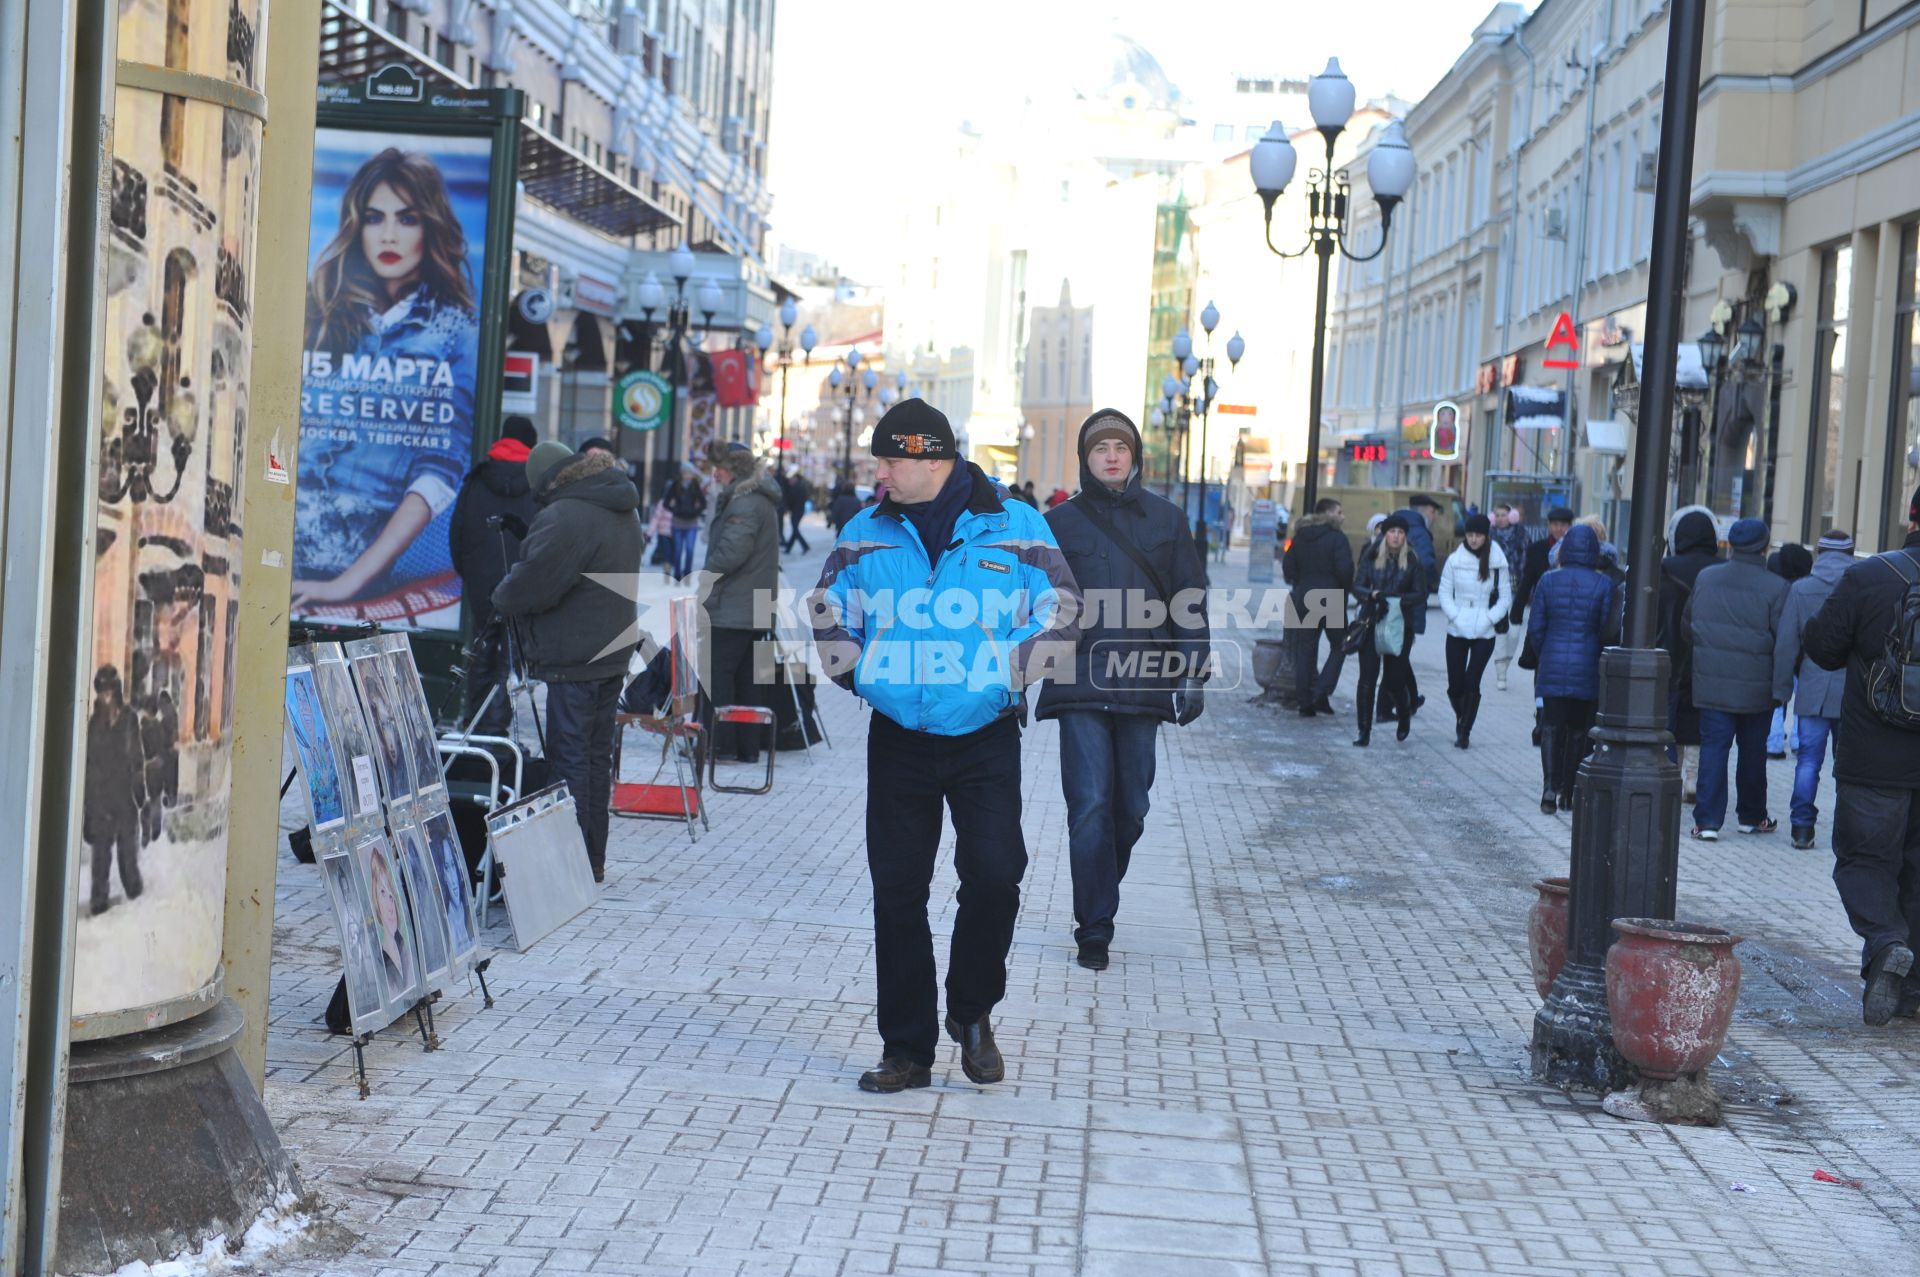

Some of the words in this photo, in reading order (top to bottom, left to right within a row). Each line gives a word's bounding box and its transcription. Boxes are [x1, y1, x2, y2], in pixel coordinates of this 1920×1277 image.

[342, 354, 454, 387] МАРТА
[303, 378, 390, 394] РАНДИОЗНОЕ
[394, 385, 454, 399] ОТКРЫТИЕ
[301, 392, 454, 423] RESERVED
[301, 417, 333, 428] ОВЫЙ
[368, 432, 438, 448] ТВЕРСКАЯ
[442, 440, 451, 450] 9
